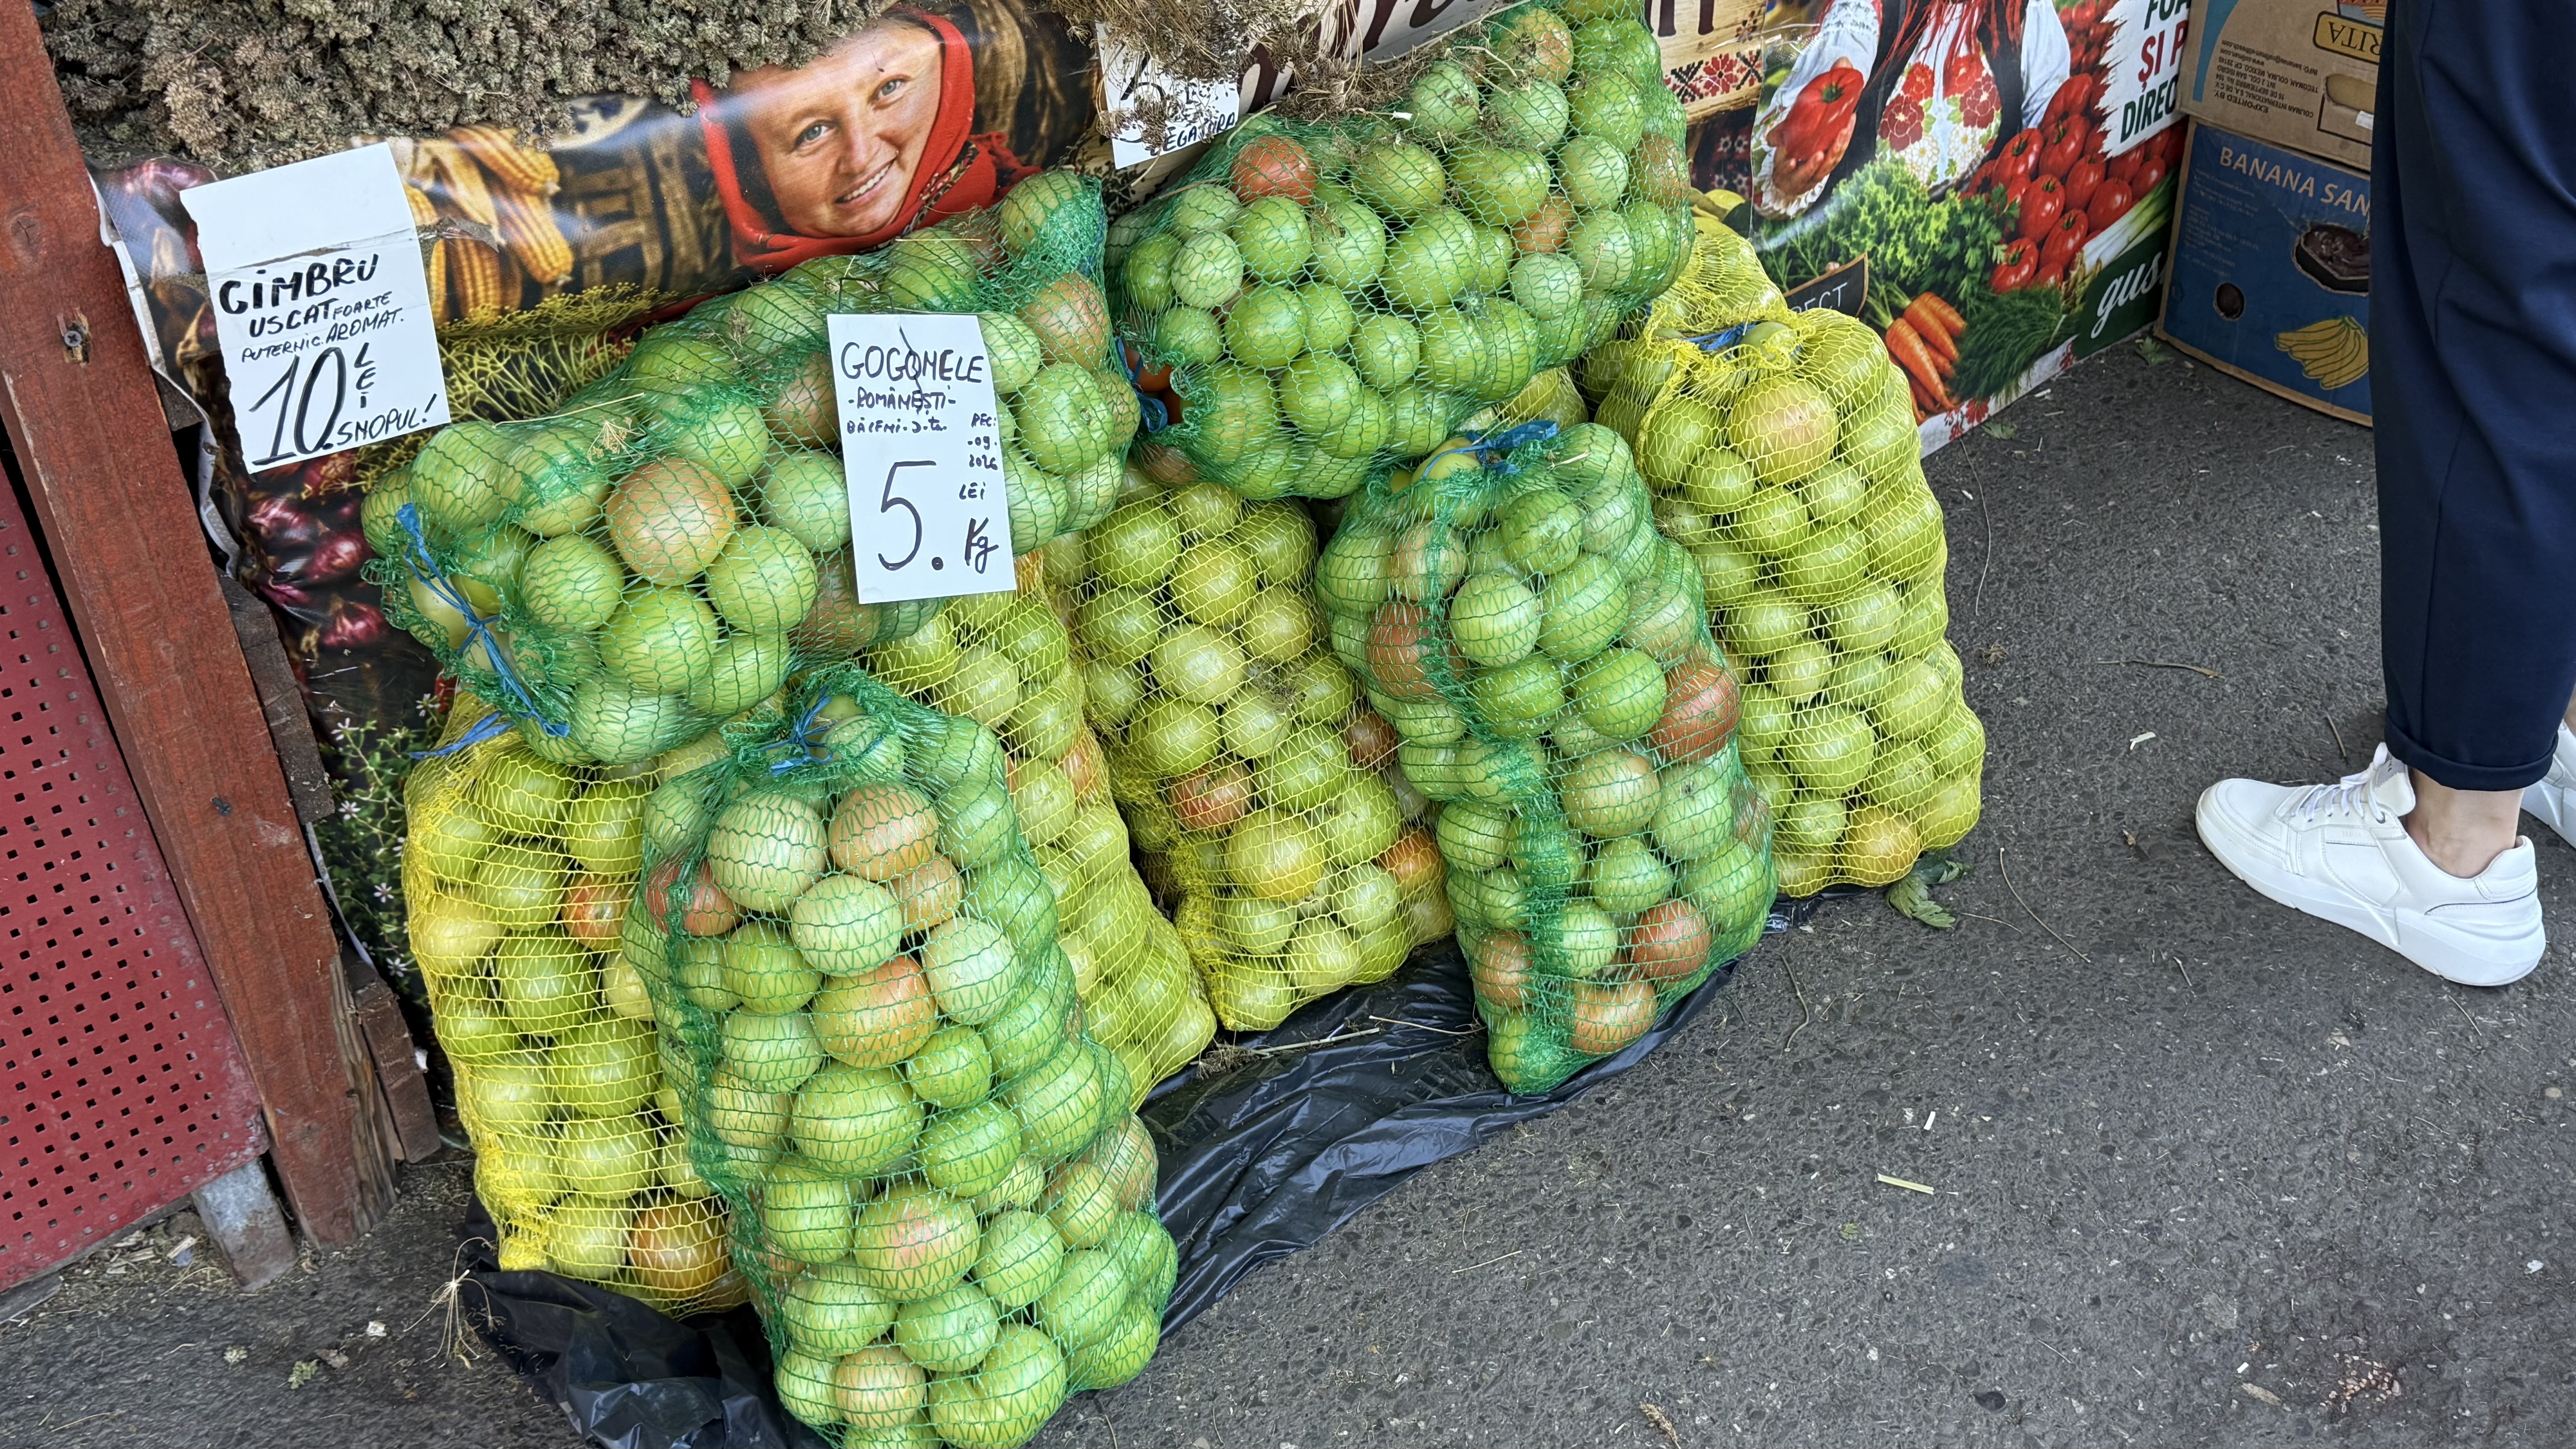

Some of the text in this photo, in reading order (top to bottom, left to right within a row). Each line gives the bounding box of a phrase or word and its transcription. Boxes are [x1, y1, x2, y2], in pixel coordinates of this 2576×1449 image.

[2217, 65, 2235, 76] ISIDRO
[2236, 70, 2247, 80] SAN
[2226, 84, 2233, 92] DE
[2236, 79, 2269, 95] SEPTIEMBRE
[2270, 90, 2277, 98] DE
[2227, 94, 2268, 114] EXPORTED
[2245, 91, 2287, 110] INTERNATIONAL
[2220, 147, 2315, 198] BANANA
[249, 291, 392, 338] USCAT FOARTE
[841, 342, 984, 383] GOGONELE
[959, 481, 985, 500] LEI
[964, 517, 999, 575] Kg
